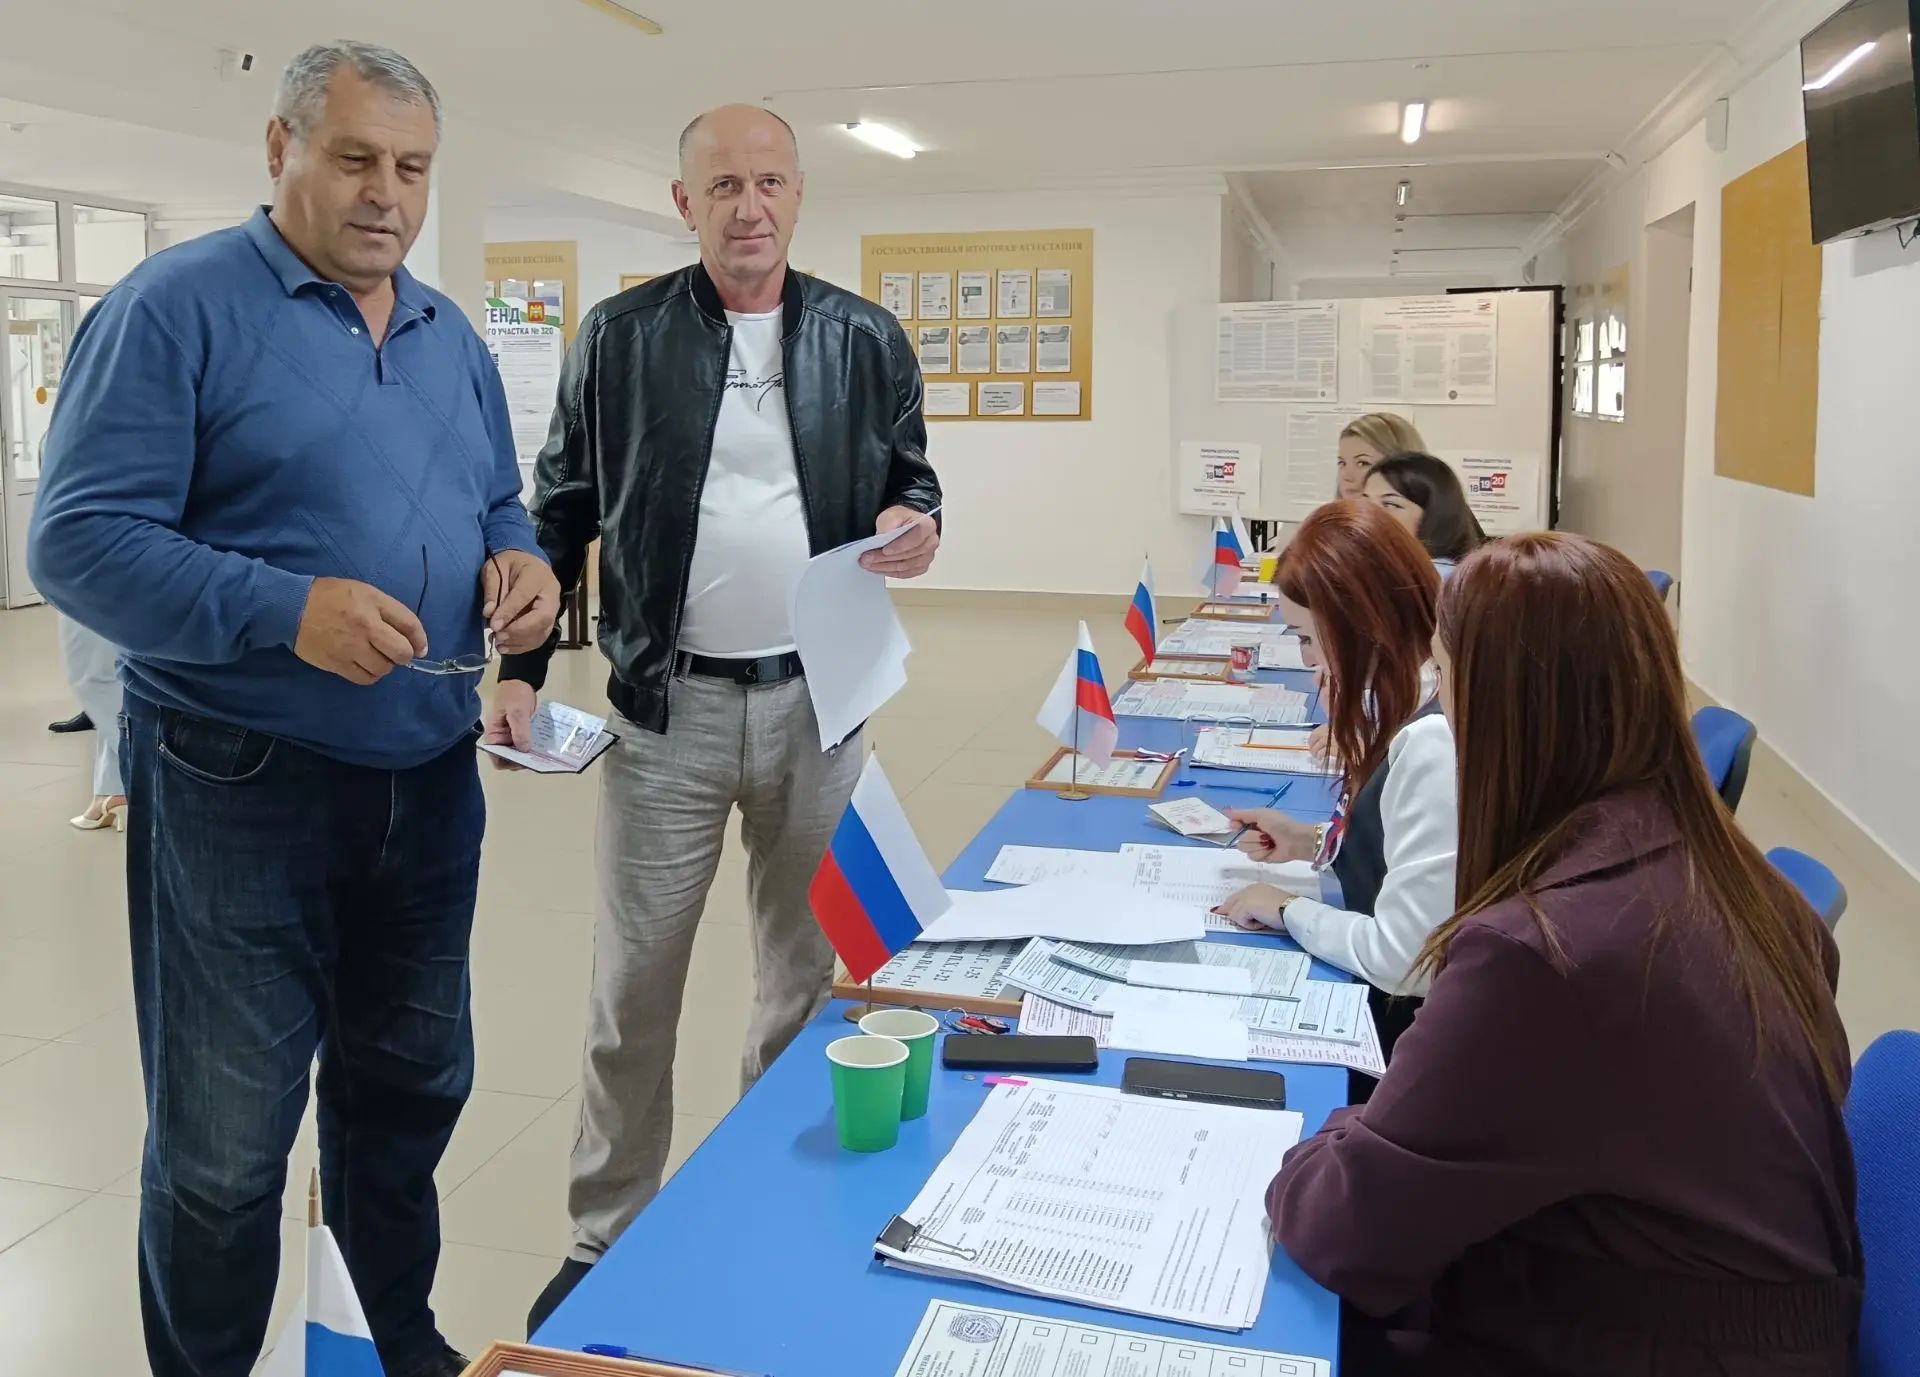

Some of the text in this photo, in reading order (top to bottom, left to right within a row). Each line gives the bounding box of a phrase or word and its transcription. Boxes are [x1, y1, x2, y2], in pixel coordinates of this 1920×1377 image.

[498, 327, 530, 336] УЧАСТКА
[541, 326, 554, 335] 320
[1223, 465, 1233, 473] 20
[1492, 476, 1505, 485] 20
[933, 969, 952, 981] 1-22
